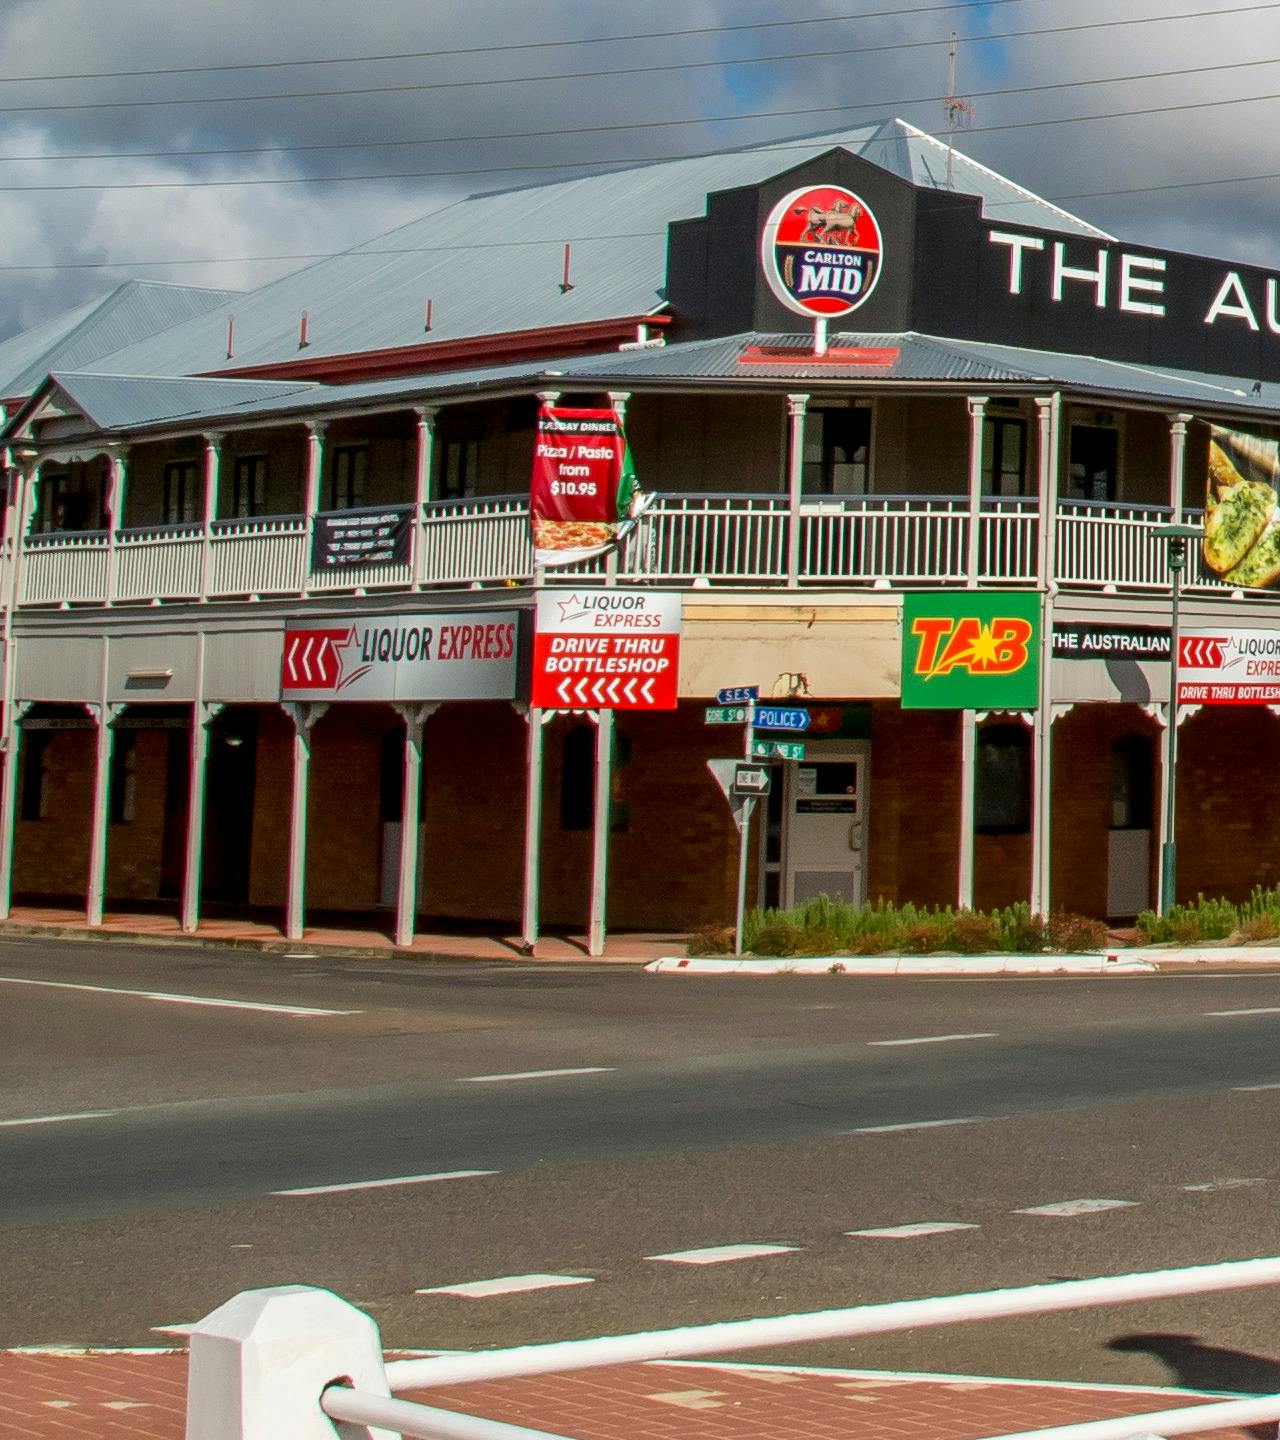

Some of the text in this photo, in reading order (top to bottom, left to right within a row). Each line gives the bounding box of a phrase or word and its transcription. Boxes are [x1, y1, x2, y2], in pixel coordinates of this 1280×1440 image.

[804, 250, 862, 267] CARLTON
[797, 264, 862, 295] MID
[989, 230, 1167, 317] THE
[537, 445, 614, 459] Pizza Pasta
[559, 464, 590, 477] from
[551, 482, 597, 496] $10.95
[583, 596, 645, 610] LIQUOR
[593, 614, 663, 627] EXPRESS
[361, 623, 515, 663] LIQUOR EXPRESS
[550, 637, 664, 655] DRIVE THRU
[911, 617, 1033, 678] TAB
[1051, 634, 1170, 652] THE AUSTRALIAN
[545, 658, 669, 673] BOTTLESHOP
[1180, 686, 1208, 700] DRIVE
[1210, 686, 1236, 700] THRU
[759, 710, 798, 726] POLICE
